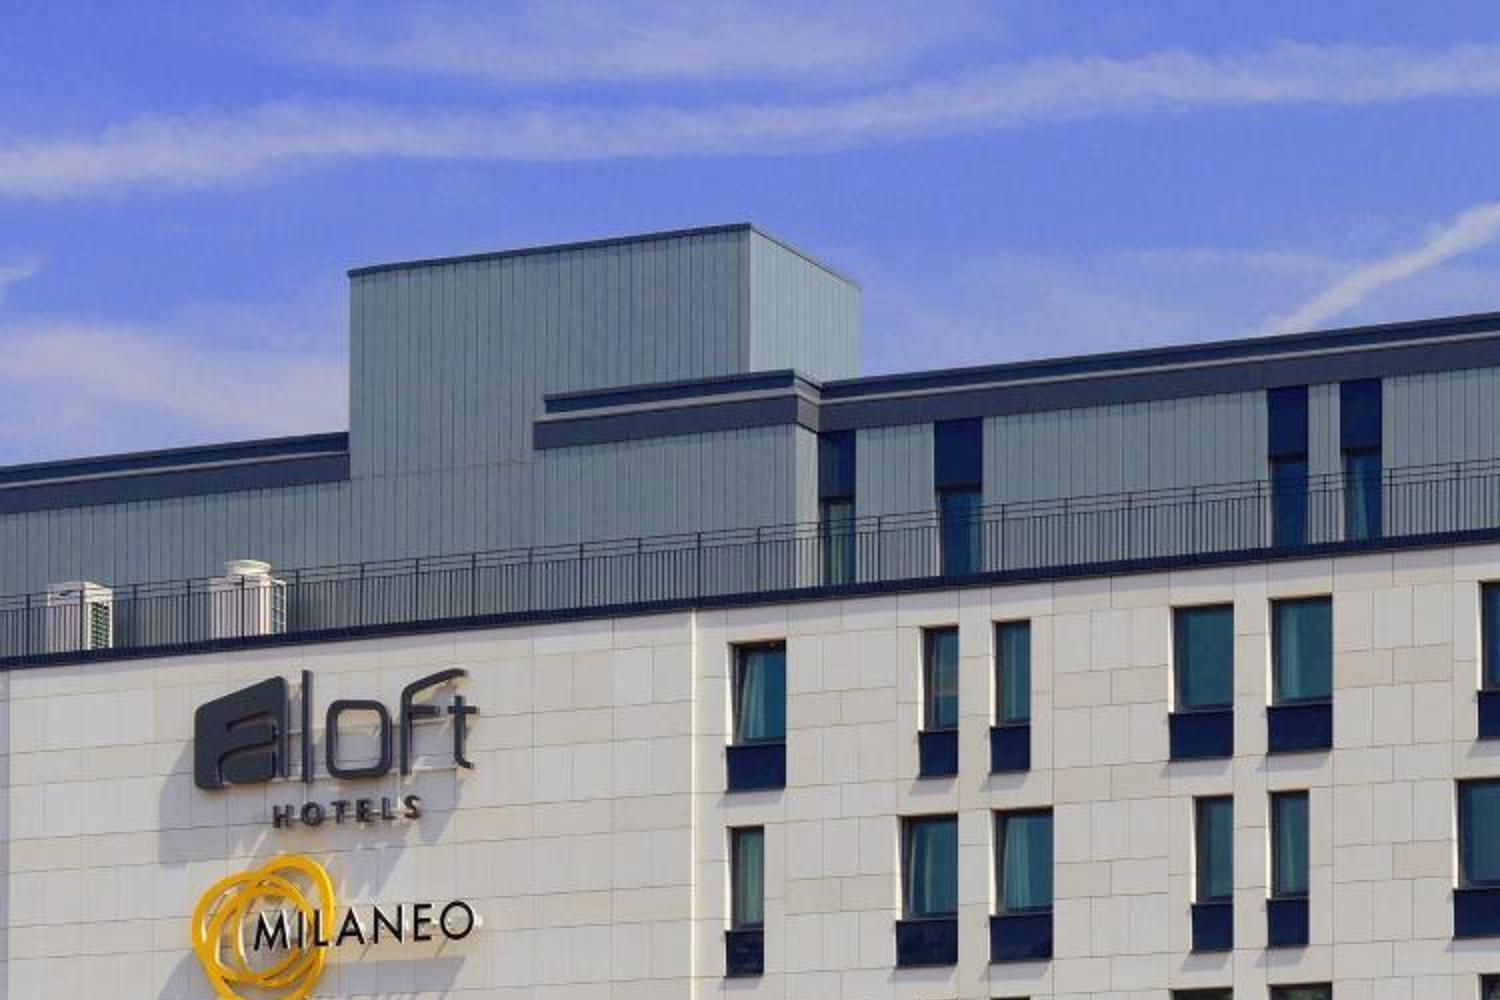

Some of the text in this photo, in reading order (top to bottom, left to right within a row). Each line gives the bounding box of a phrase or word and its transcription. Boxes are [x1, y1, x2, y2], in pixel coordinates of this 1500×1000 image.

[194, 668, 479, 789] aloft
[272, 795, 420, 829] HOTELS
[254, 901, 474, 951] MILANEO
